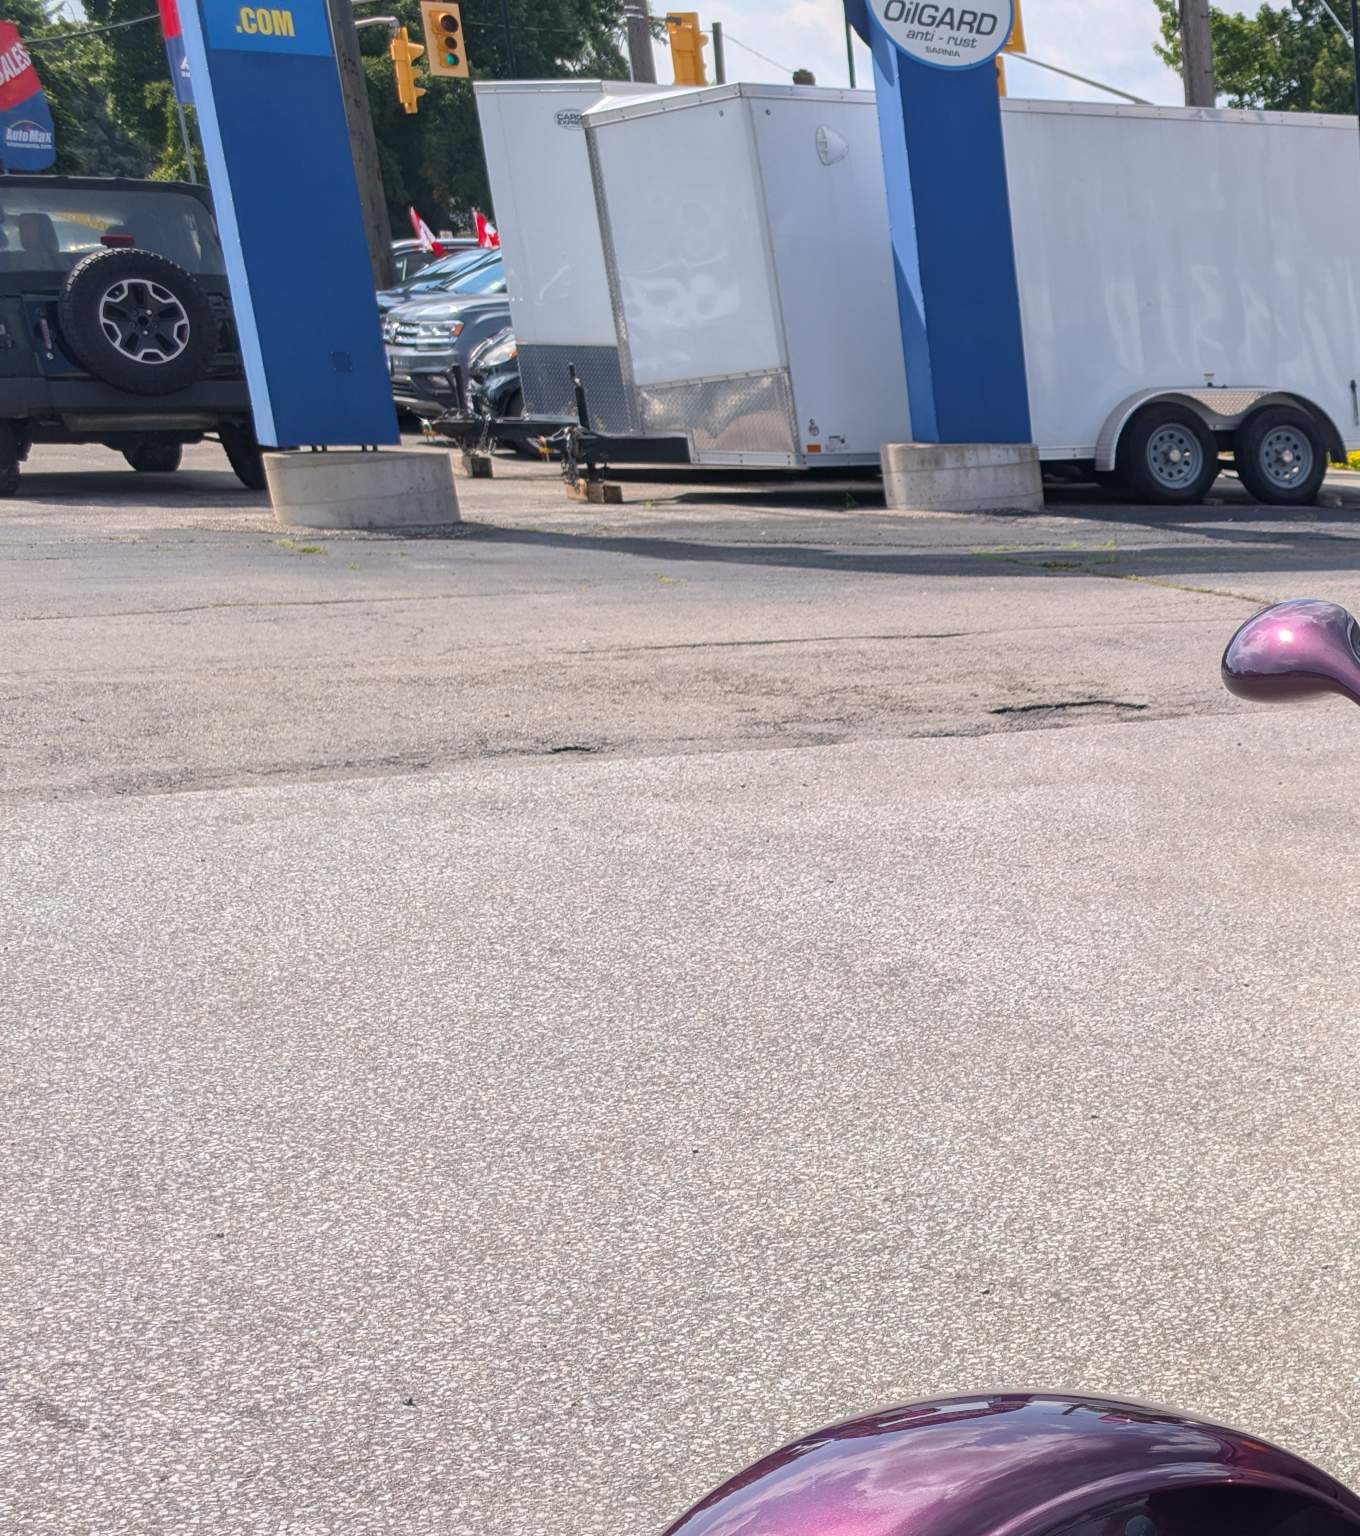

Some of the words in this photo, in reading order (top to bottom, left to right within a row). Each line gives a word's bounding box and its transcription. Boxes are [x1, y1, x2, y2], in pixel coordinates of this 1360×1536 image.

[236, 7, 296, 37] .COM
[883, 0, 998, 36] OilGARD
[906, 29, 936, 42] anti
[946, 34, 978, 49] rust
[924, 45, 961, 57] SARNIA
